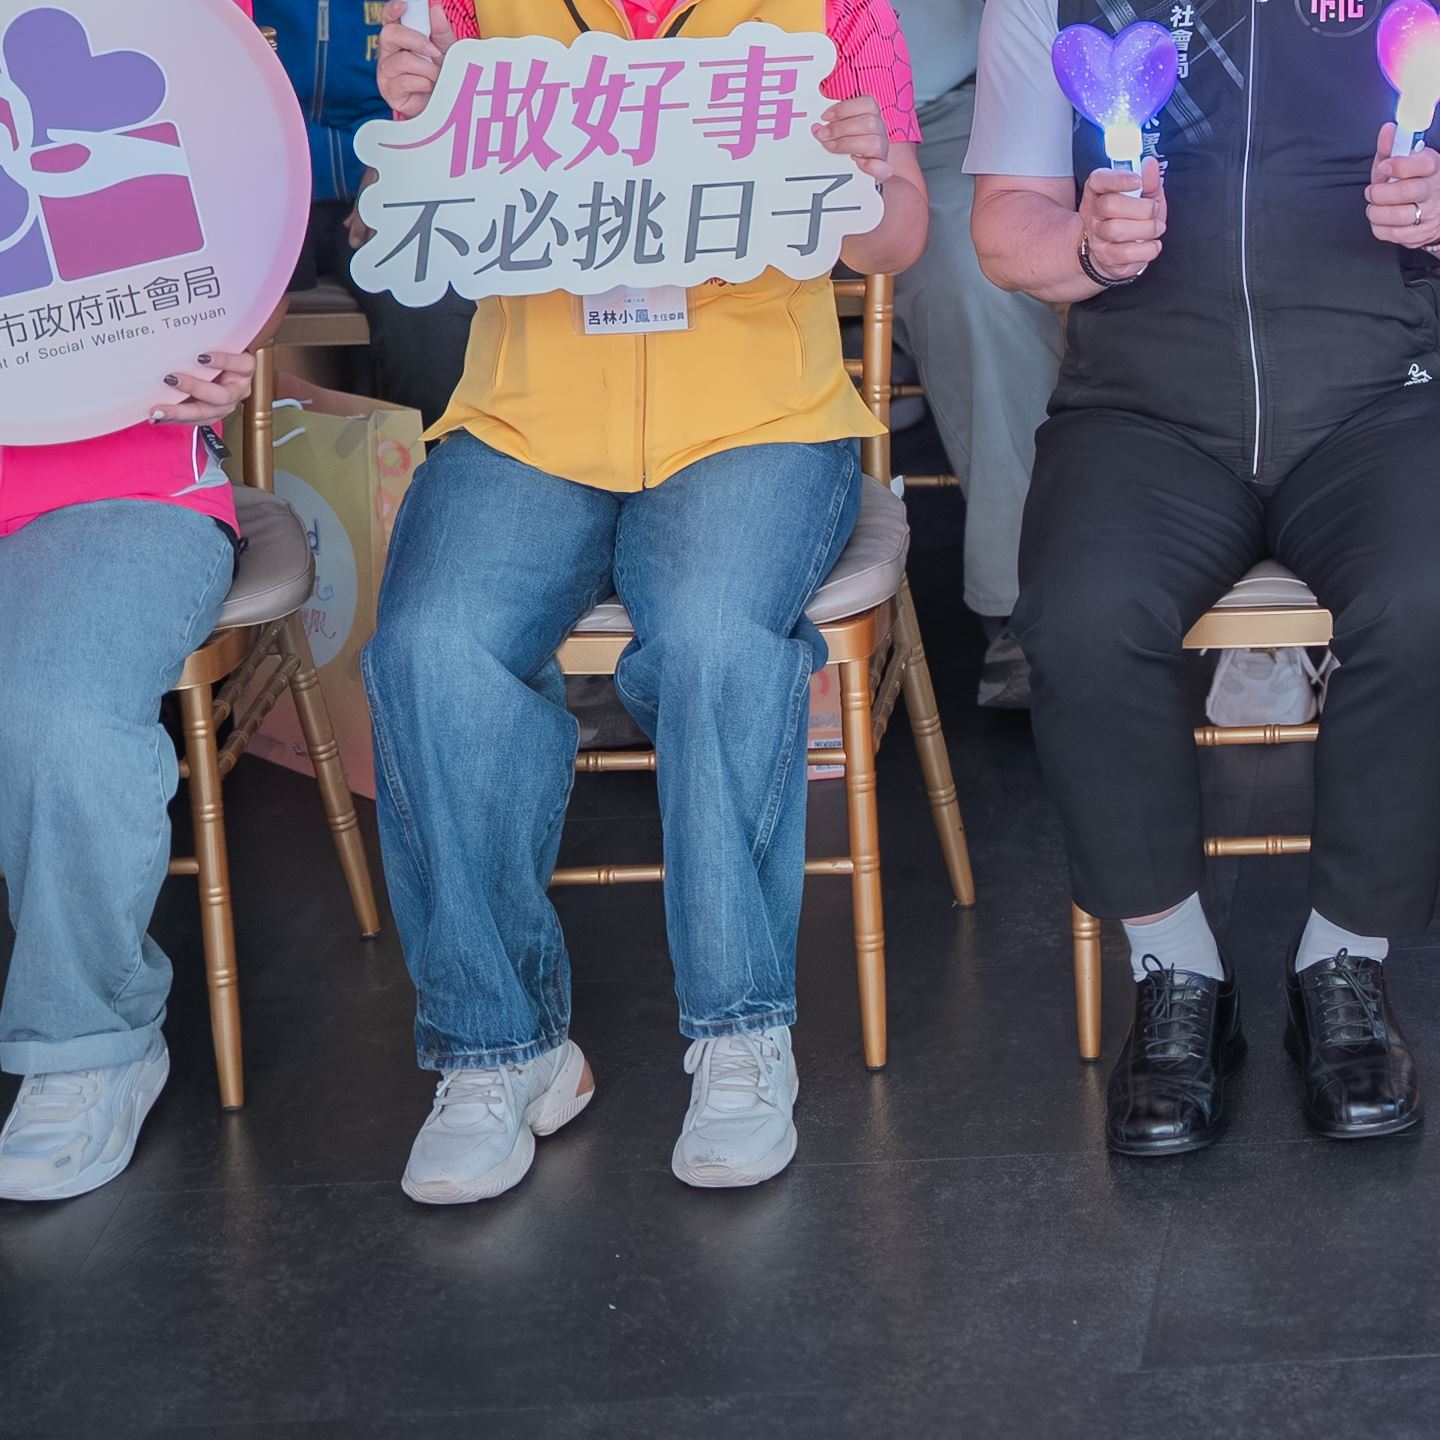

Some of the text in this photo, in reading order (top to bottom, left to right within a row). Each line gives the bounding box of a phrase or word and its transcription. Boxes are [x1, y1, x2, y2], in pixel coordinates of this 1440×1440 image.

[378, 45, 814, 178] 做好事
[375, 173, 862, 283] 不必挑日子
[16, 351, 30, 365] of
[38, 339, 85, 360] Social
[91, 324, 155, 347] Welfare,
[162, 306, 227, 331] Taoyuan
